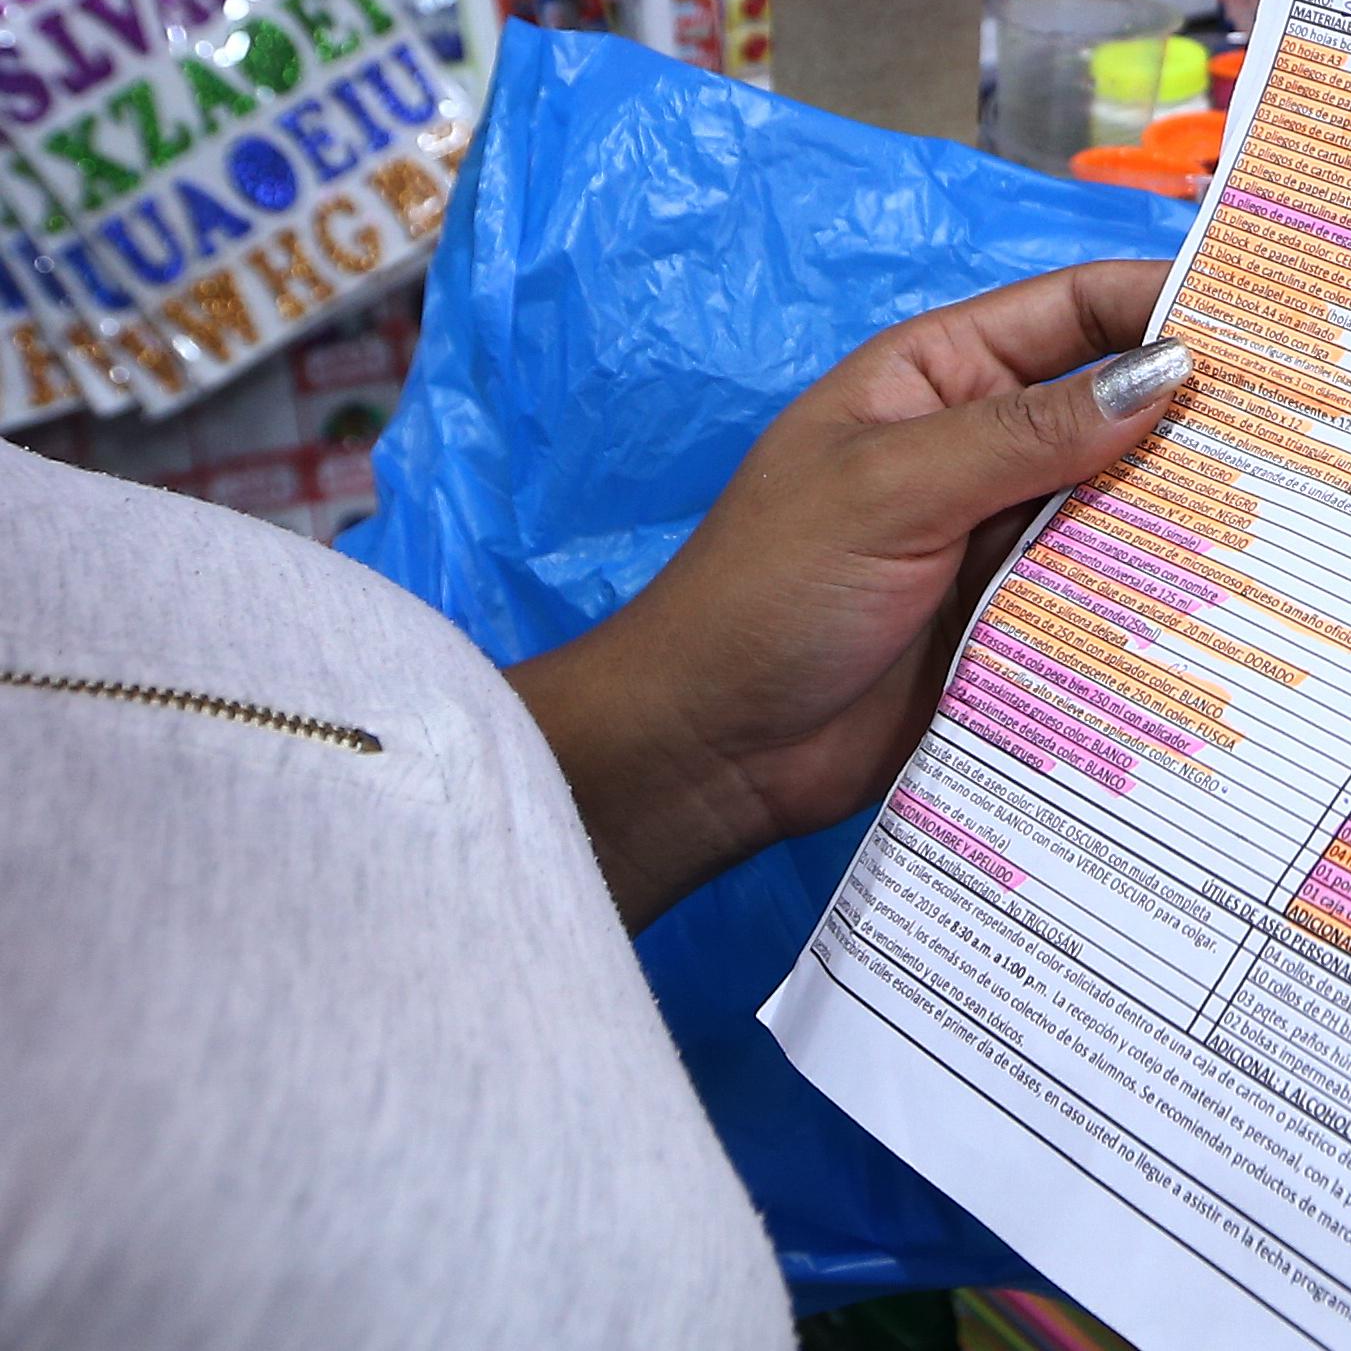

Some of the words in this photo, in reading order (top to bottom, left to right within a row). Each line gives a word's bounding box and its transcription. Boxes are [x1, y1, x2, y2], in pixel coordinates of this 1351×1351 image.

[1287, 21, 1310, 36] 500
[1309, 27, 1339, 46] hojas
[1282, 40, 1298, 52] 20
[1297, 43, 1326, 61] hojas
[1326, 52, 1343, 65] A3
[1275, 55, 1292, 68] 05
[1290, 61, 1330, 81] pliegos
[1330, 72, 1346, 86] de
[1327, 844, 1348, 862] 04
[1199, 877, 1244, 913] ÚTILES
[1241, 904, 1262, 924] DE
[1259, 915, 1296, 944] ASEO
[1262, 946, 1283, 965] 04
[1280, 959, 1317, 987] rollos
[1315, 977, 1335, 997] de
[1208, 1033, 1284, 1091] ADICIONAL:
